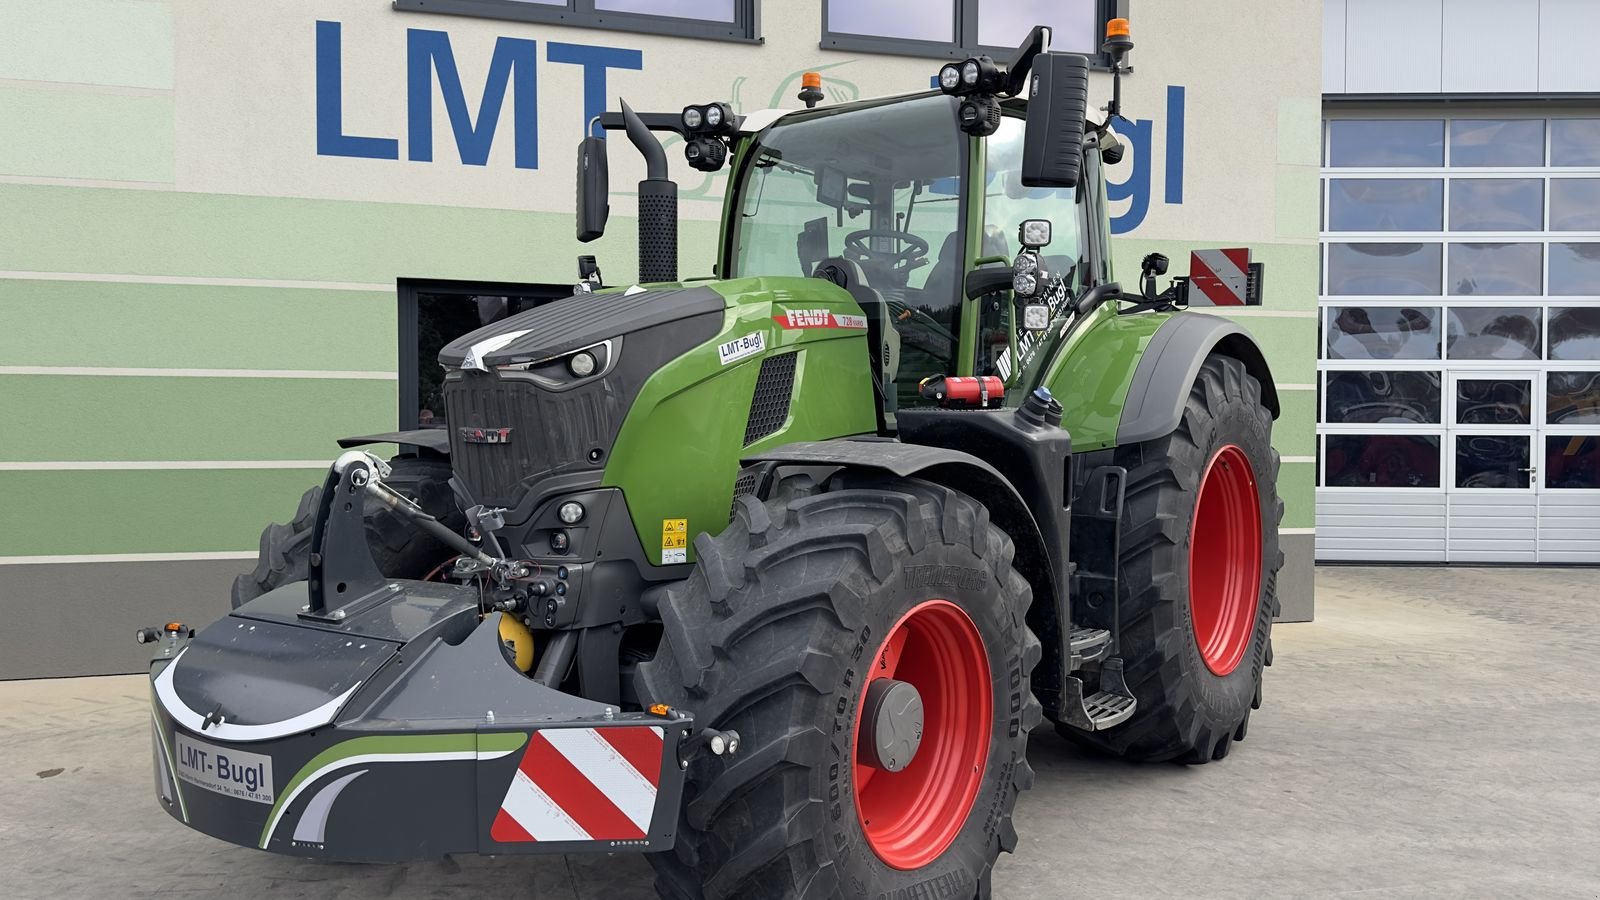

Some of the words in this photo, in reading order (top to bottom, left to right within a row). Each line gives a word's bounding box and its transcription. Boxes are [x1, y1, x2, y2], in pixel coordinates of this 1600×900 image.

[315, 20, 643, 170] LMT
[785, 309, 830, 327] FENDT
[721, 331, 762, 357] LMT-Bugl
